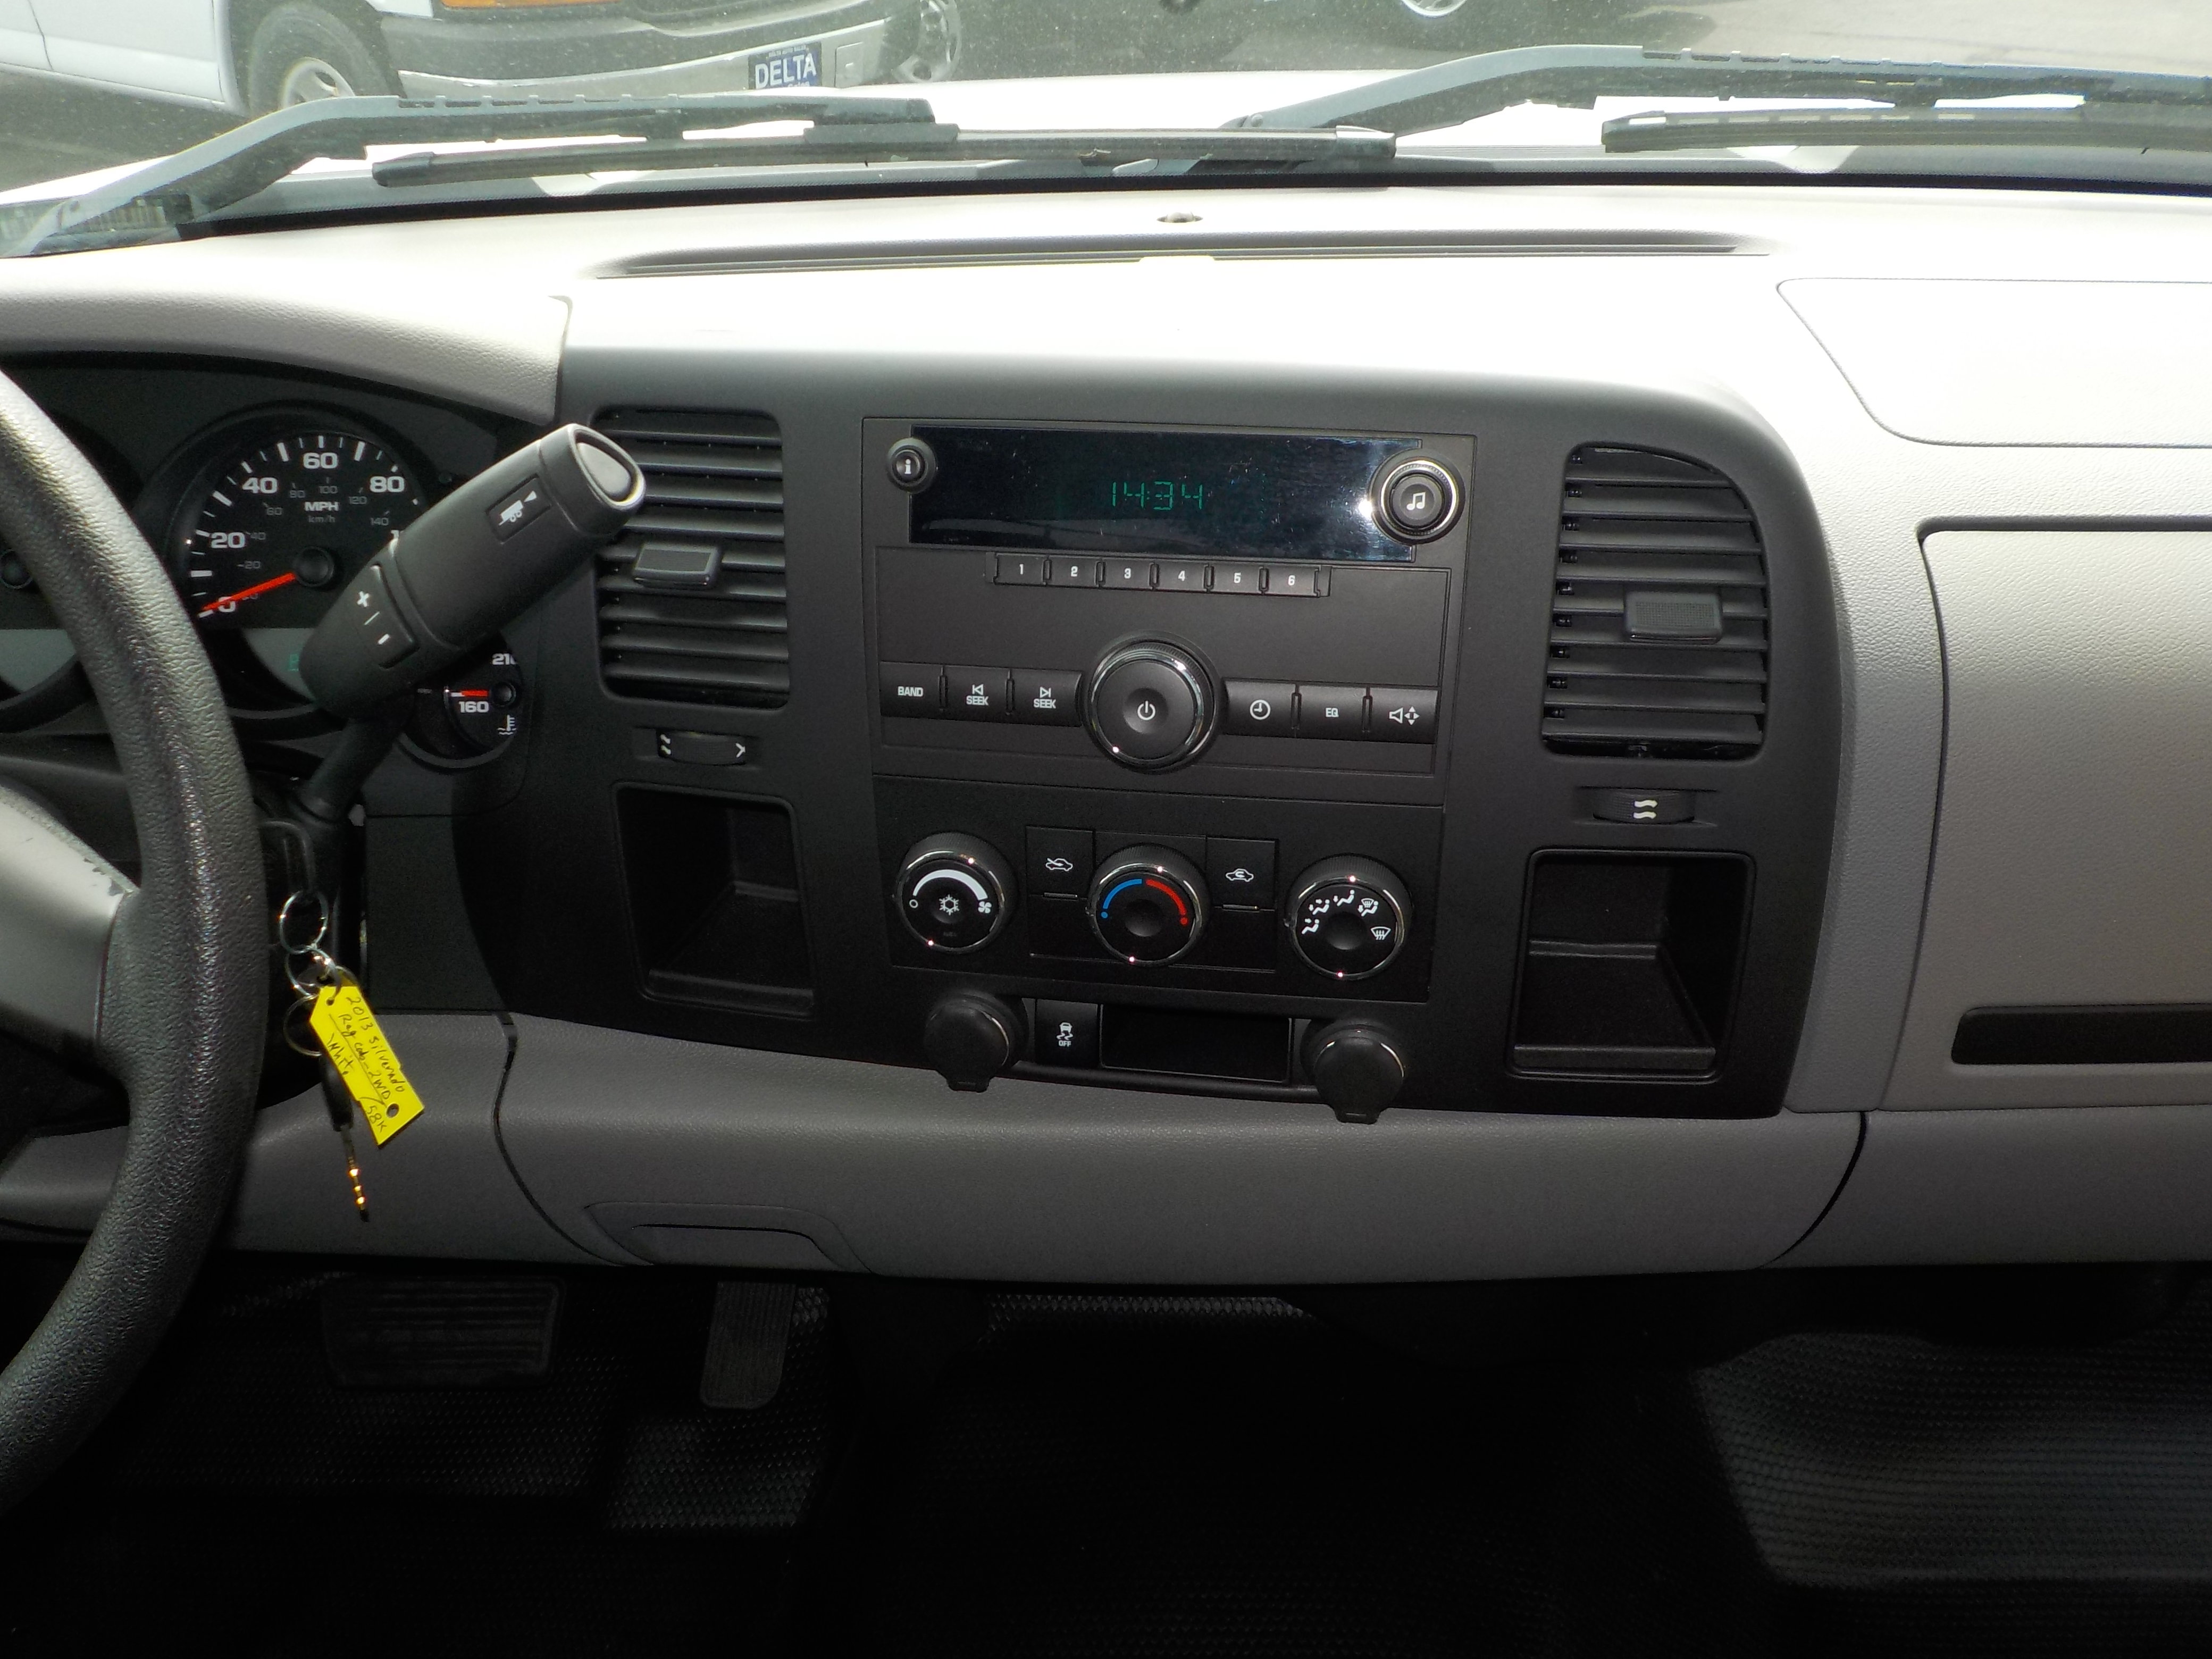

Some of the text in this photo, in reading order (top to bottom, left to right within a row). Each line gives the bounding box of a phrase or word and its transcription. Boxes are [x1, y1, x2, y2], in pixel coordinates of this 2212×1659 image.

[755, 53, 817, 89] DELTA
[303, 453, 338, 469] 60
[242, 477, 278, 494] 40
[319, 485, 338, 494] 100
[370, 476, 405, 492] 80
[289, 490, 305, 498] 80
[1112, 481, 1203, 510] 14:34
[349, 496, 367, 505] 120
[305, 501, 339, 512] MPH
[308, 515, 336, 523] km/h
[371, 517, 389, 526] 140
[211, 532, 246, 549] 20
[250, 532, 266, 540] 40
[1019, 564, 1024, 575] 1
[1070, 566, 1078, 577] 2
[1124, 568, 1132, 579] 3
[1178, 570, 1185, 581] 4
[1234, 573, 1241, 583] 5
[1288, 575, 1295, 585] 6
[898, 686, 924, 697] BAND
[966, 696, 988, 706] SEEK
[1033, 699, 1056, 709] SEEK
[459, 701, 489, 713] 160
[1326, 707, 1339, 717] EQ
[346, 996, 373, 1030] 2013
